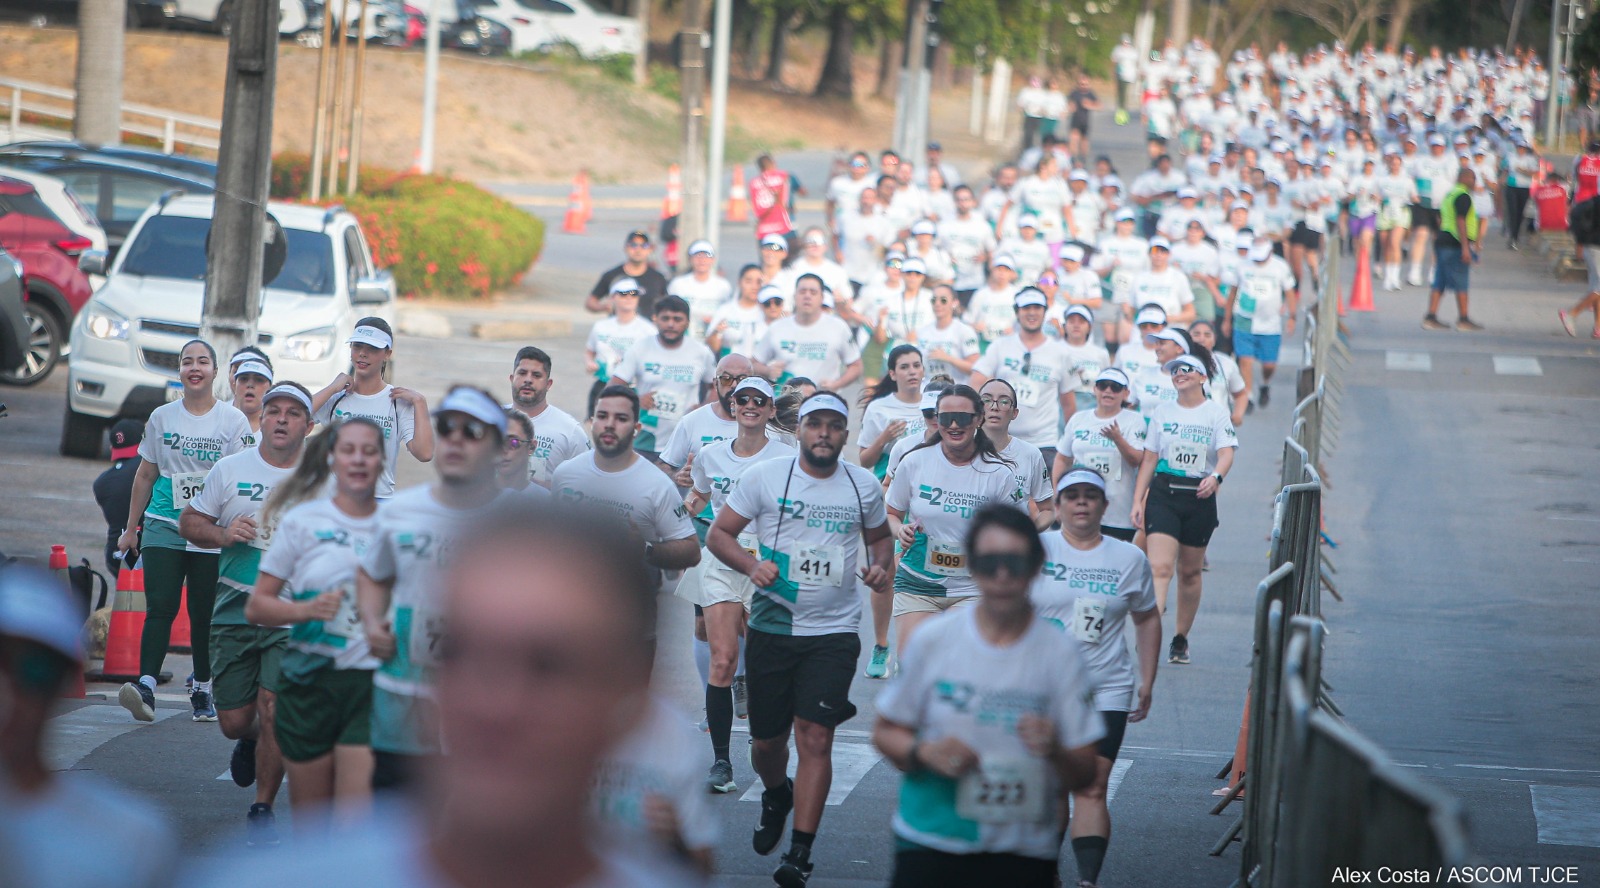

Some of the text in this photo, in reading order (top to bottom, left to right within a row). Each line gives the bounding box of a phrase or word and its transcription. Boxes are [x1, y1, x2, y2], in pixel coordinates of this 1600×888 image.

[185, 436, 224, 445] CAMINHADA
[1102, 438, 1116, 448] TJC
[1192, 434, 1211, 445] TJCE
[182, 448, 222, 462] DO TJCE
[1175, 453, 1198, 465] 407
[948, 491, 989, 502] CAMINHADA
[811, 504, 858, 514] CAMINHADA
[943, 504, 958, 514] DO
[807, 518, 854, 534] DO TJCE
[936, 554, 960, 567] 909
[800, 559, 831, 577] 411
[1069, 580, 1118, 596] DO TJCE
